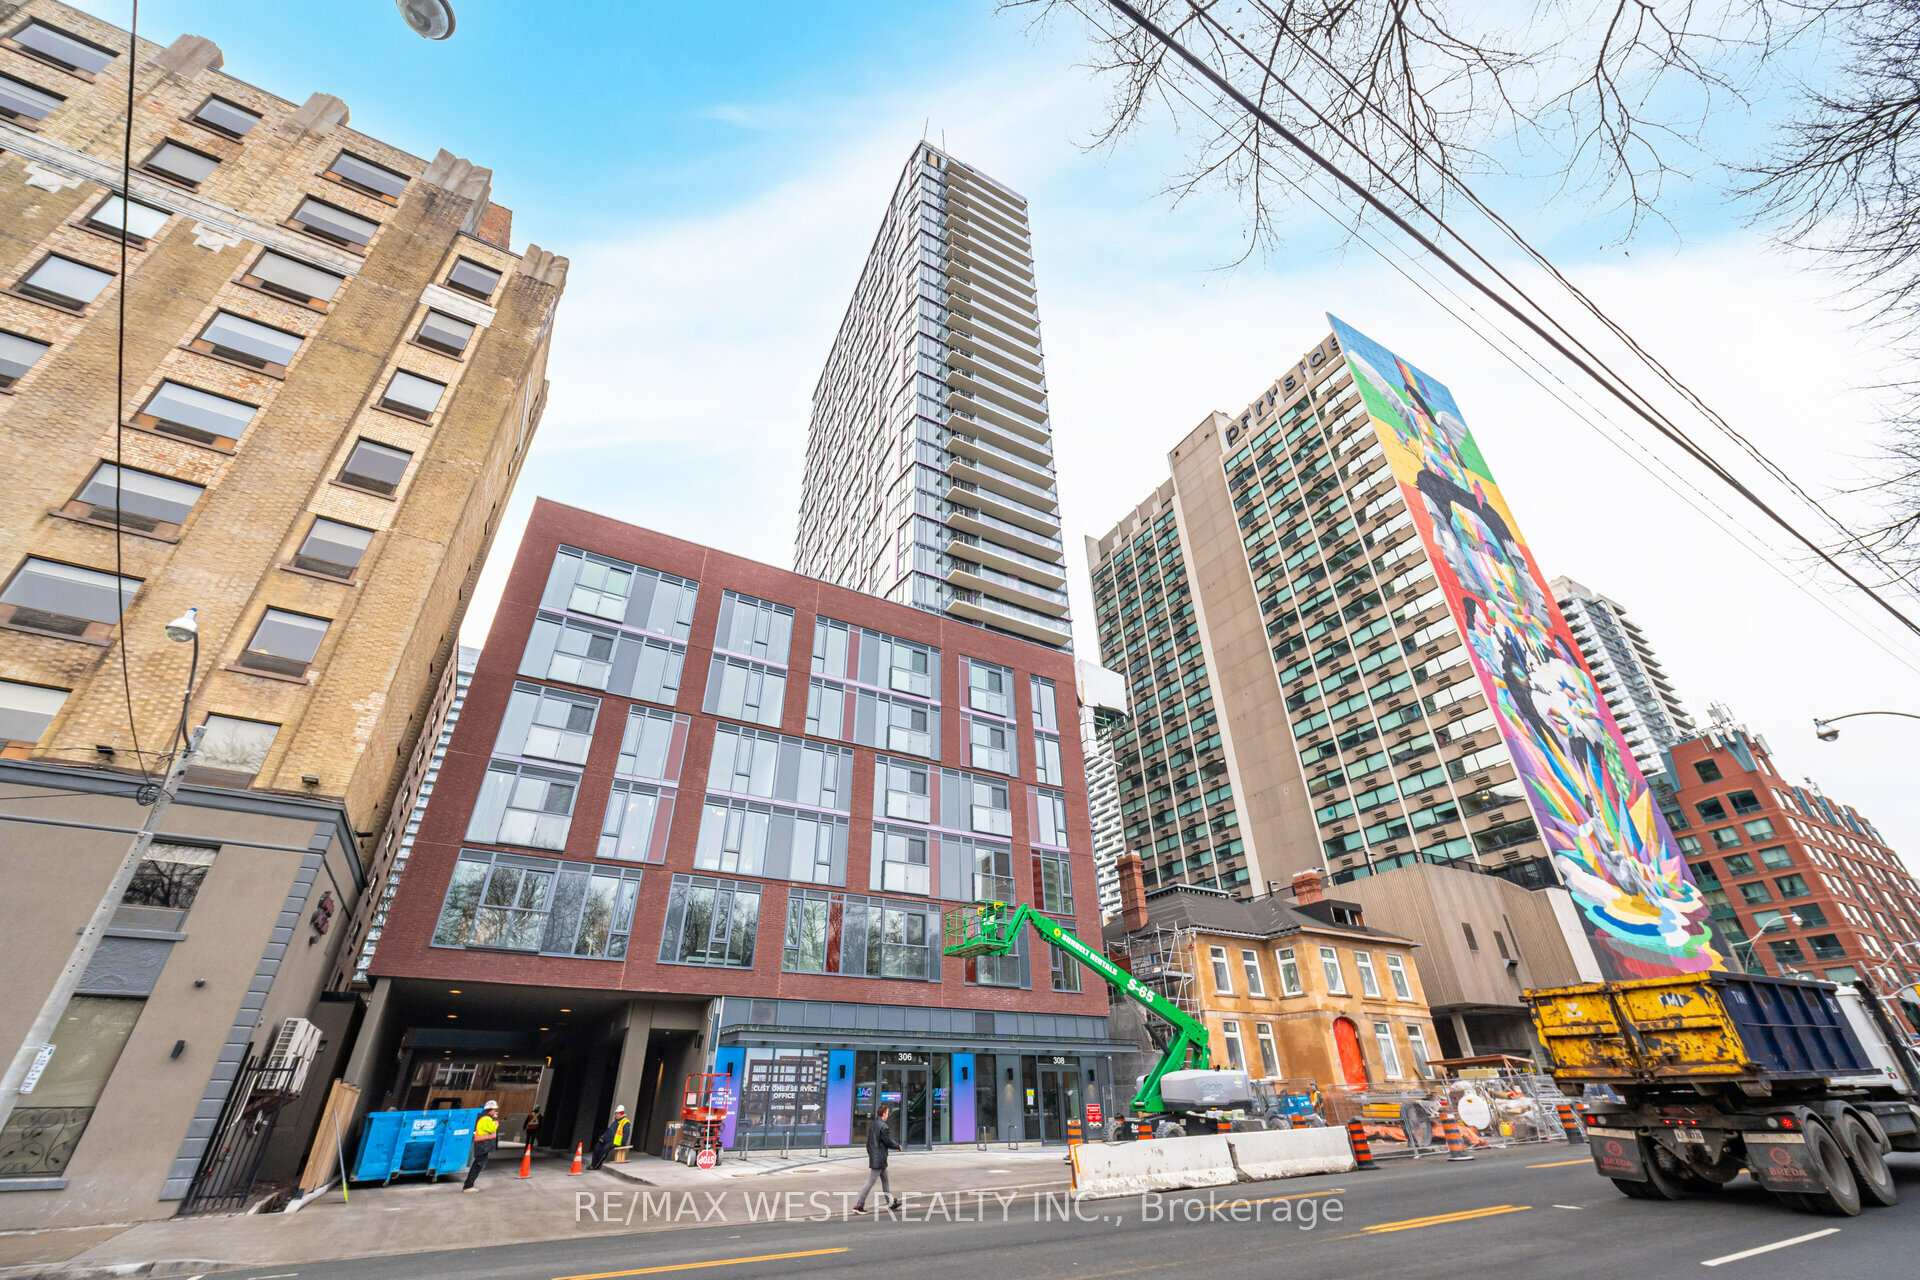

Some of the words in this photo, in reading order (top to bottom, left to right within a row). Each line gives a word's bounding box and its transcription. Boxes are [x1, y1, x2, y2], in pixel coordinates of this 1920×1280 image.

[1126, 978, 1155, 1003] S-65
[898, 1052, 912, 1061] 306
[1053, 1056, 1065, 1065] 308
[698, 1155, 715, 1164] STOP
